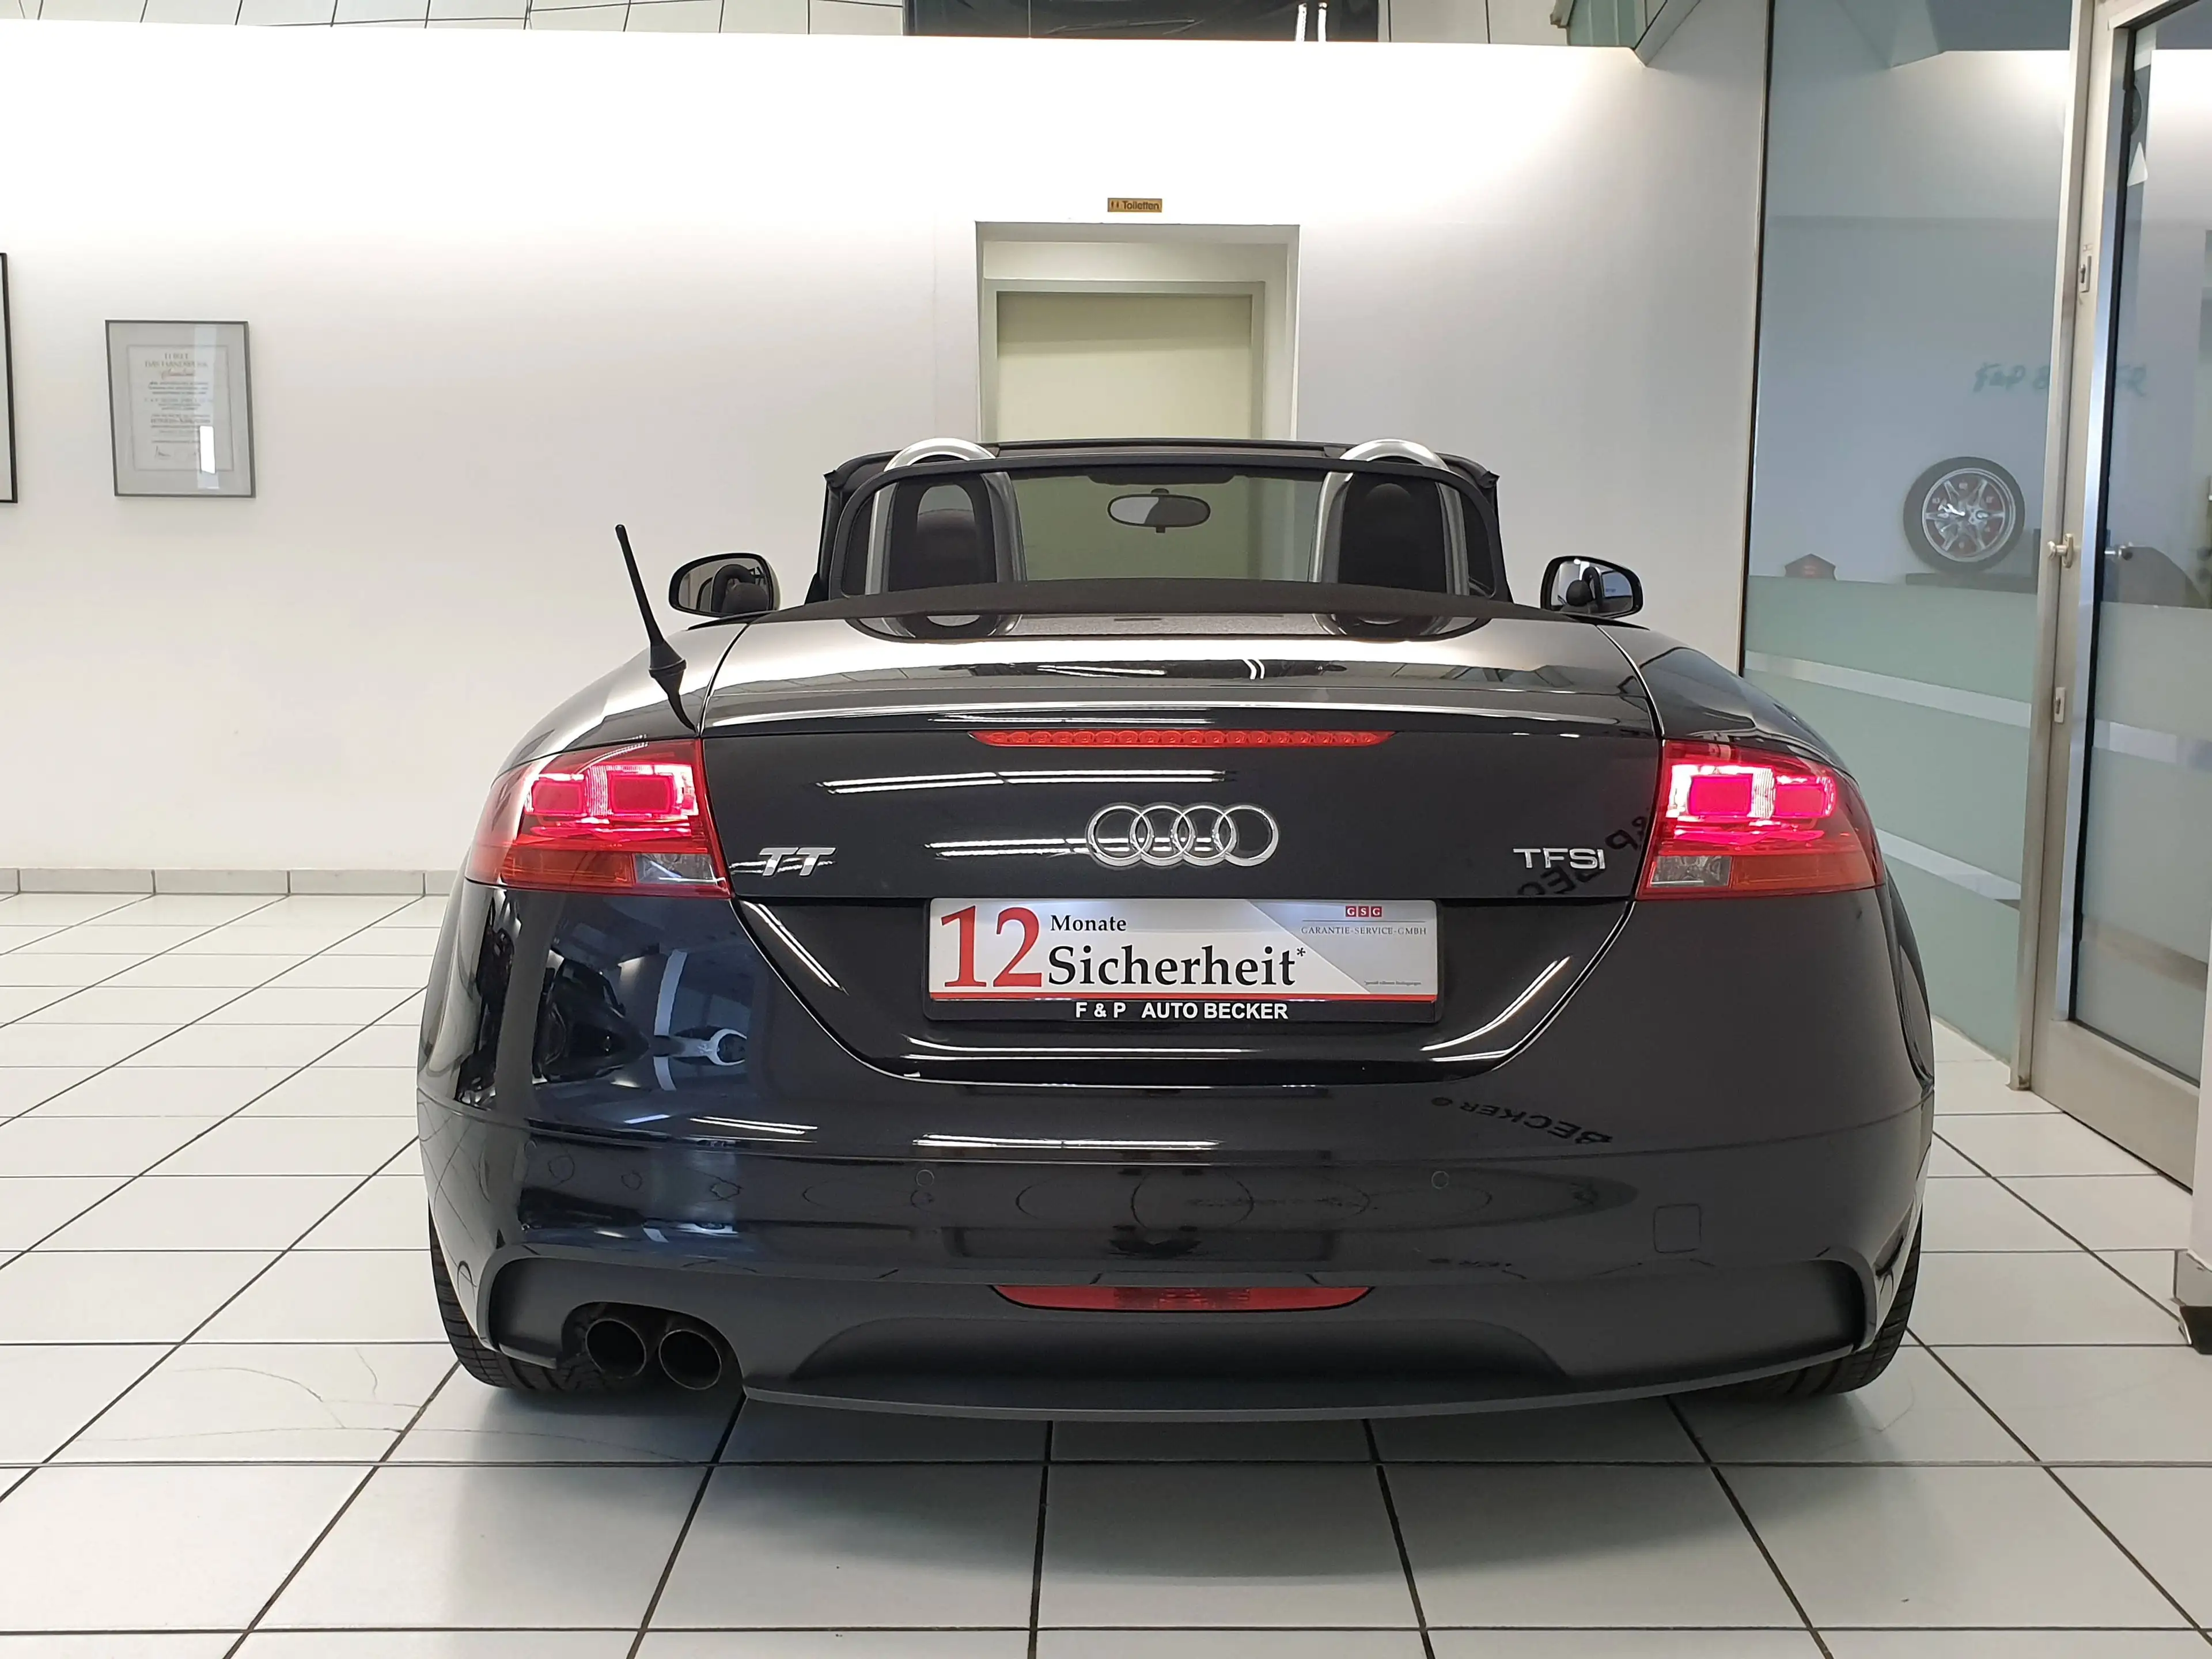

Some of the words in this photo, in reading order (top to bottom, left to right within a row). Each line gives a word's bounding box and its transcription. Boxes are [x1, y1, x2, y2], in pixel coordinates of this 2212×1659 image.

[1122, 200, 1160, 210] Toiletten
[759, 847, 836, 877] TT
[1513, 847, 1606, 870] TFSI
[1346, 906, 1382, 917] GSG
[1050, 914, 1127, 932] Monate
[941, 904, 1042, 987] 12
[1075, 1002, 1088, 1018] F
[1094, 1002, 1107, 1018] &
[1113, 1002, 1126, 1018] P
[1141, 1002, 1198, 1019] AUTO
[1204, 1002, 1289, 1020] BECKER
